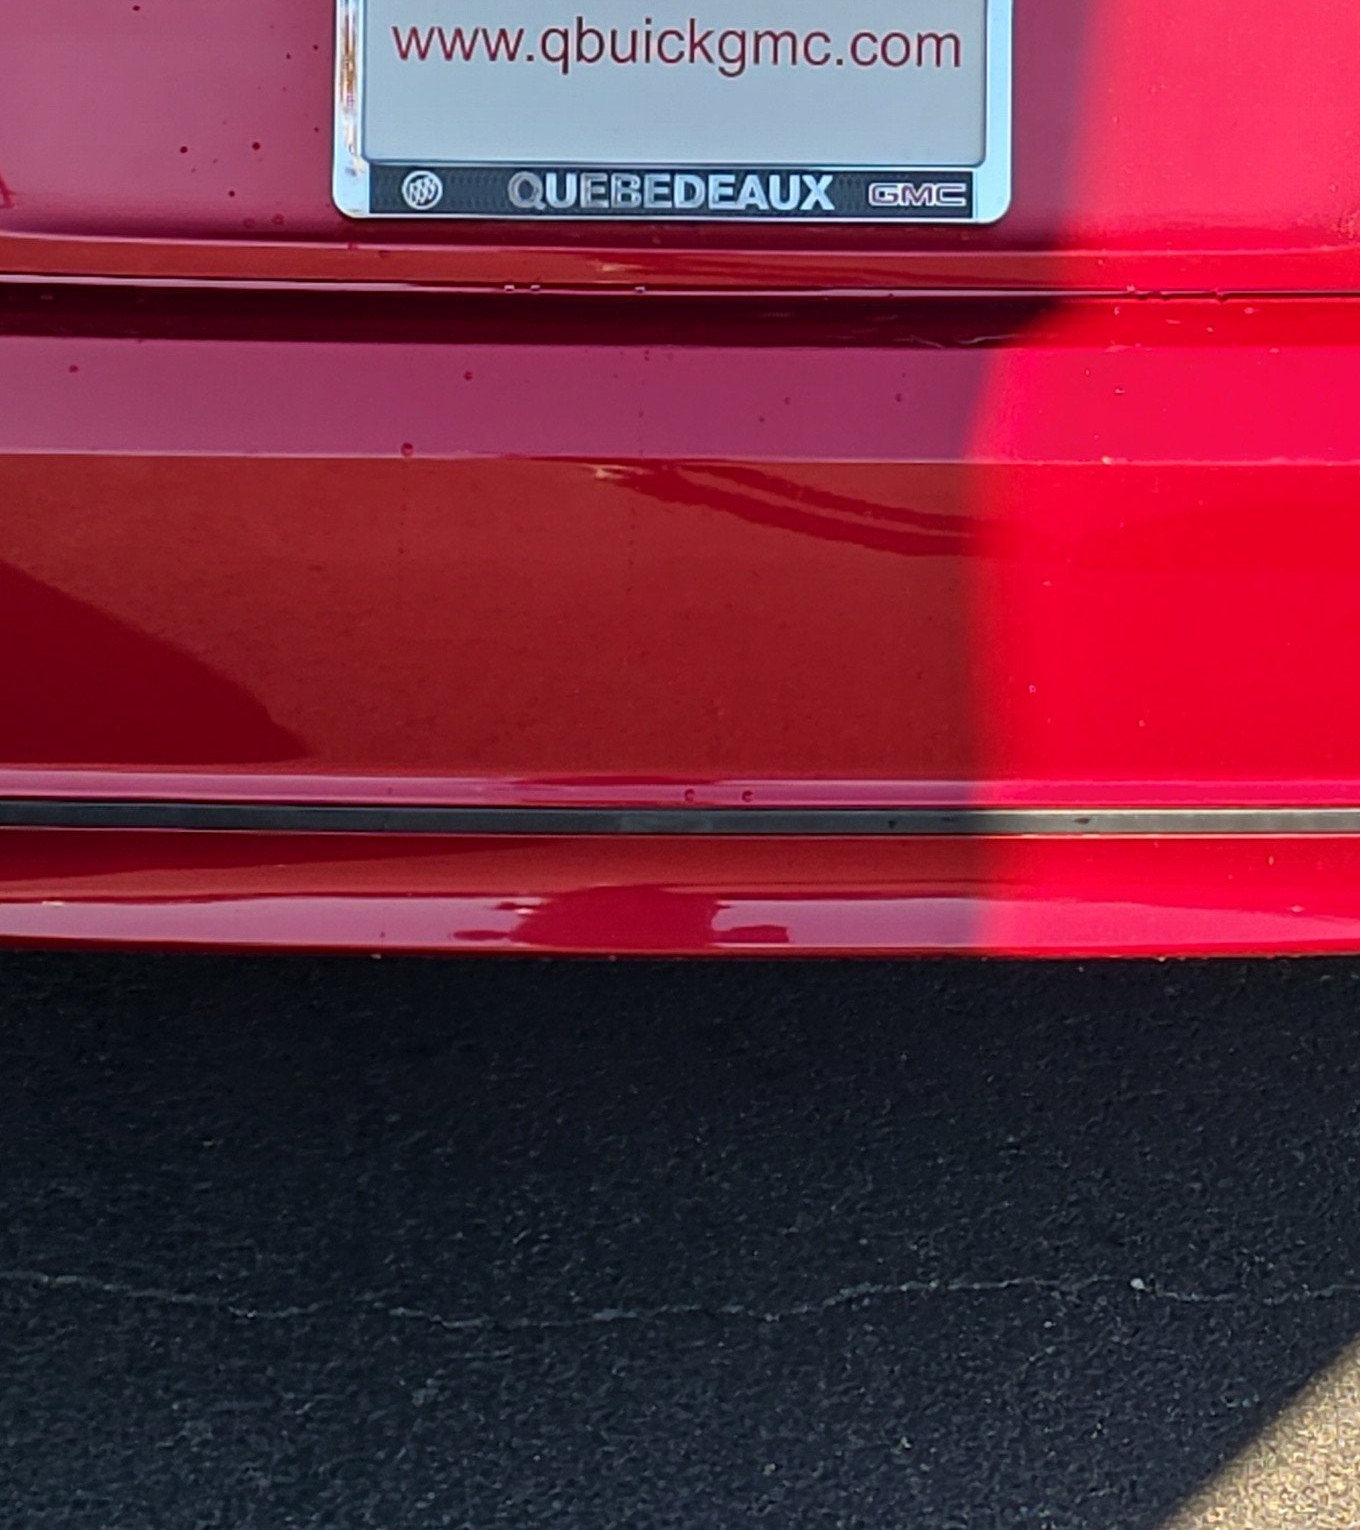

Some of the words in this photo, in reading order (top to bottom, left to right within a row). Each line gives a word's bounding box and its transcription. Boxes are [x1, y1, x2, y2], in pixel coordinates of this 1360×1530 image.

[391, 16, 961, 78] www.qbuickgmc.com
[507, 171, 835, 211] QUEBEDEAUX
[868, 182, 967, 207] GMC
